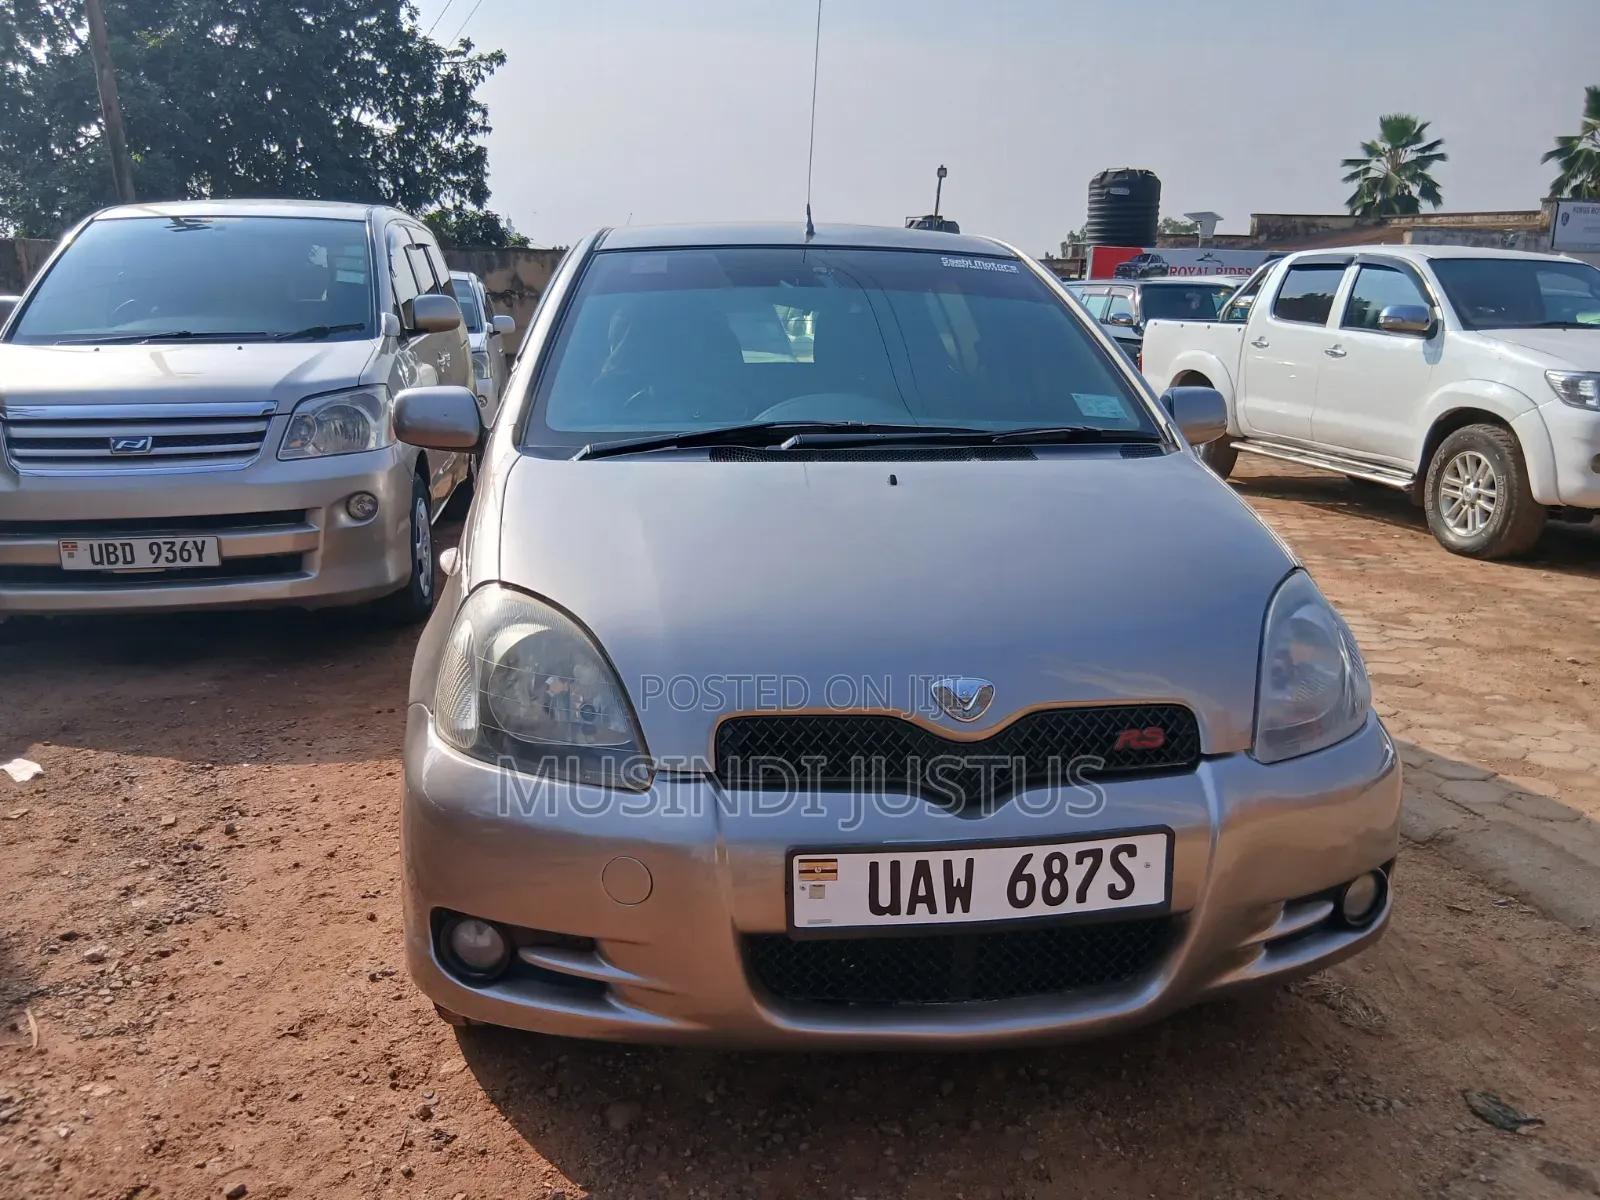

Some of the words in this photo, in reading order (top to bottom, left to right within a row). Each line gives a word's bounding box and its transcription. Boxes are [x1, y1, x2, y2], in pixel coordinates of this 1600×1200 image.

[89, 542, 136, 566] UBD
[148, 540, 206, 564] 936Y
[1114, 726, 1166, 752] RS
[868, 857, 975, 917] UAW
[1006, 843, 1138, 910] 687S
